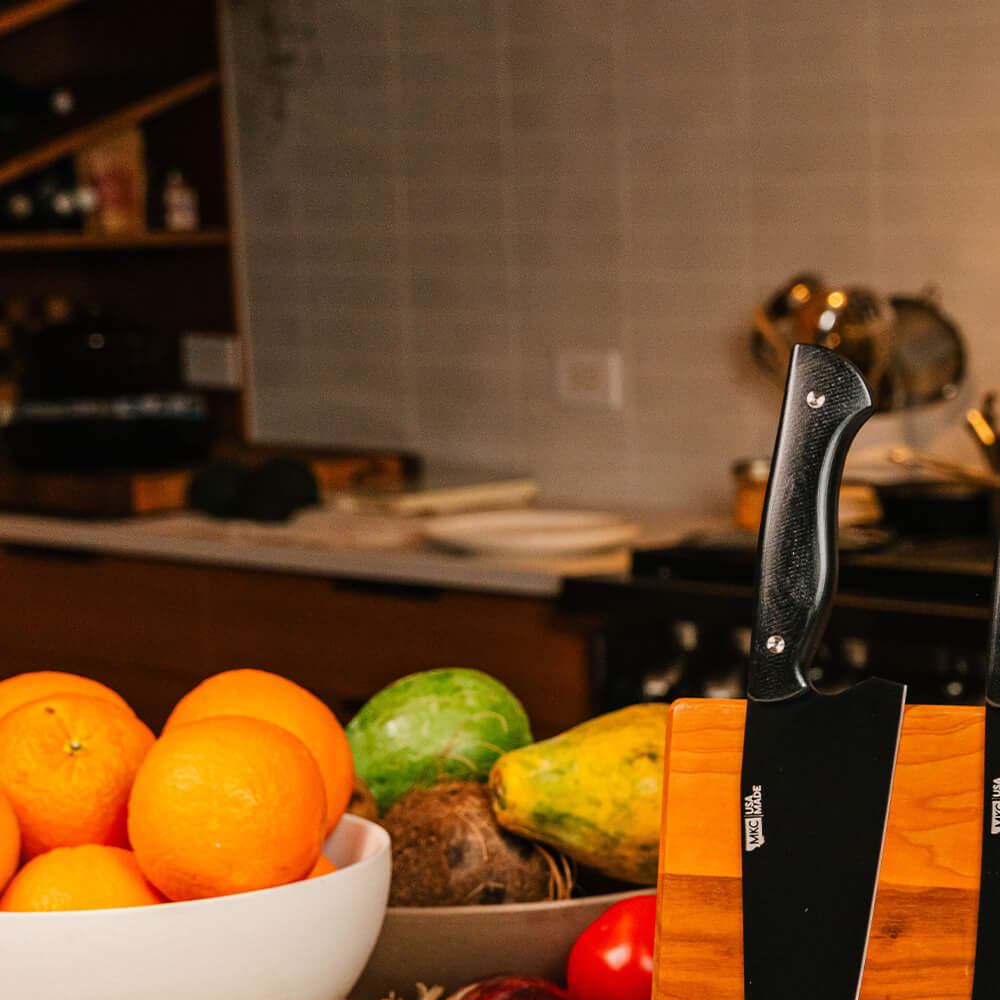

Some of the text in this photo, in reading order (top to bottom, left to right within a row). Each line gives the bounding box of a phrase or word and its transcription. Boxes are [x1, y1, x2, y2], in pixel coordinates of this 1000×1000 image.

[992, 777, 1000, 797] USA
[744, 795, 753, 815] USA
[752, 785, 762, 815] MADE
[749, 820, 760, 845] MKC
